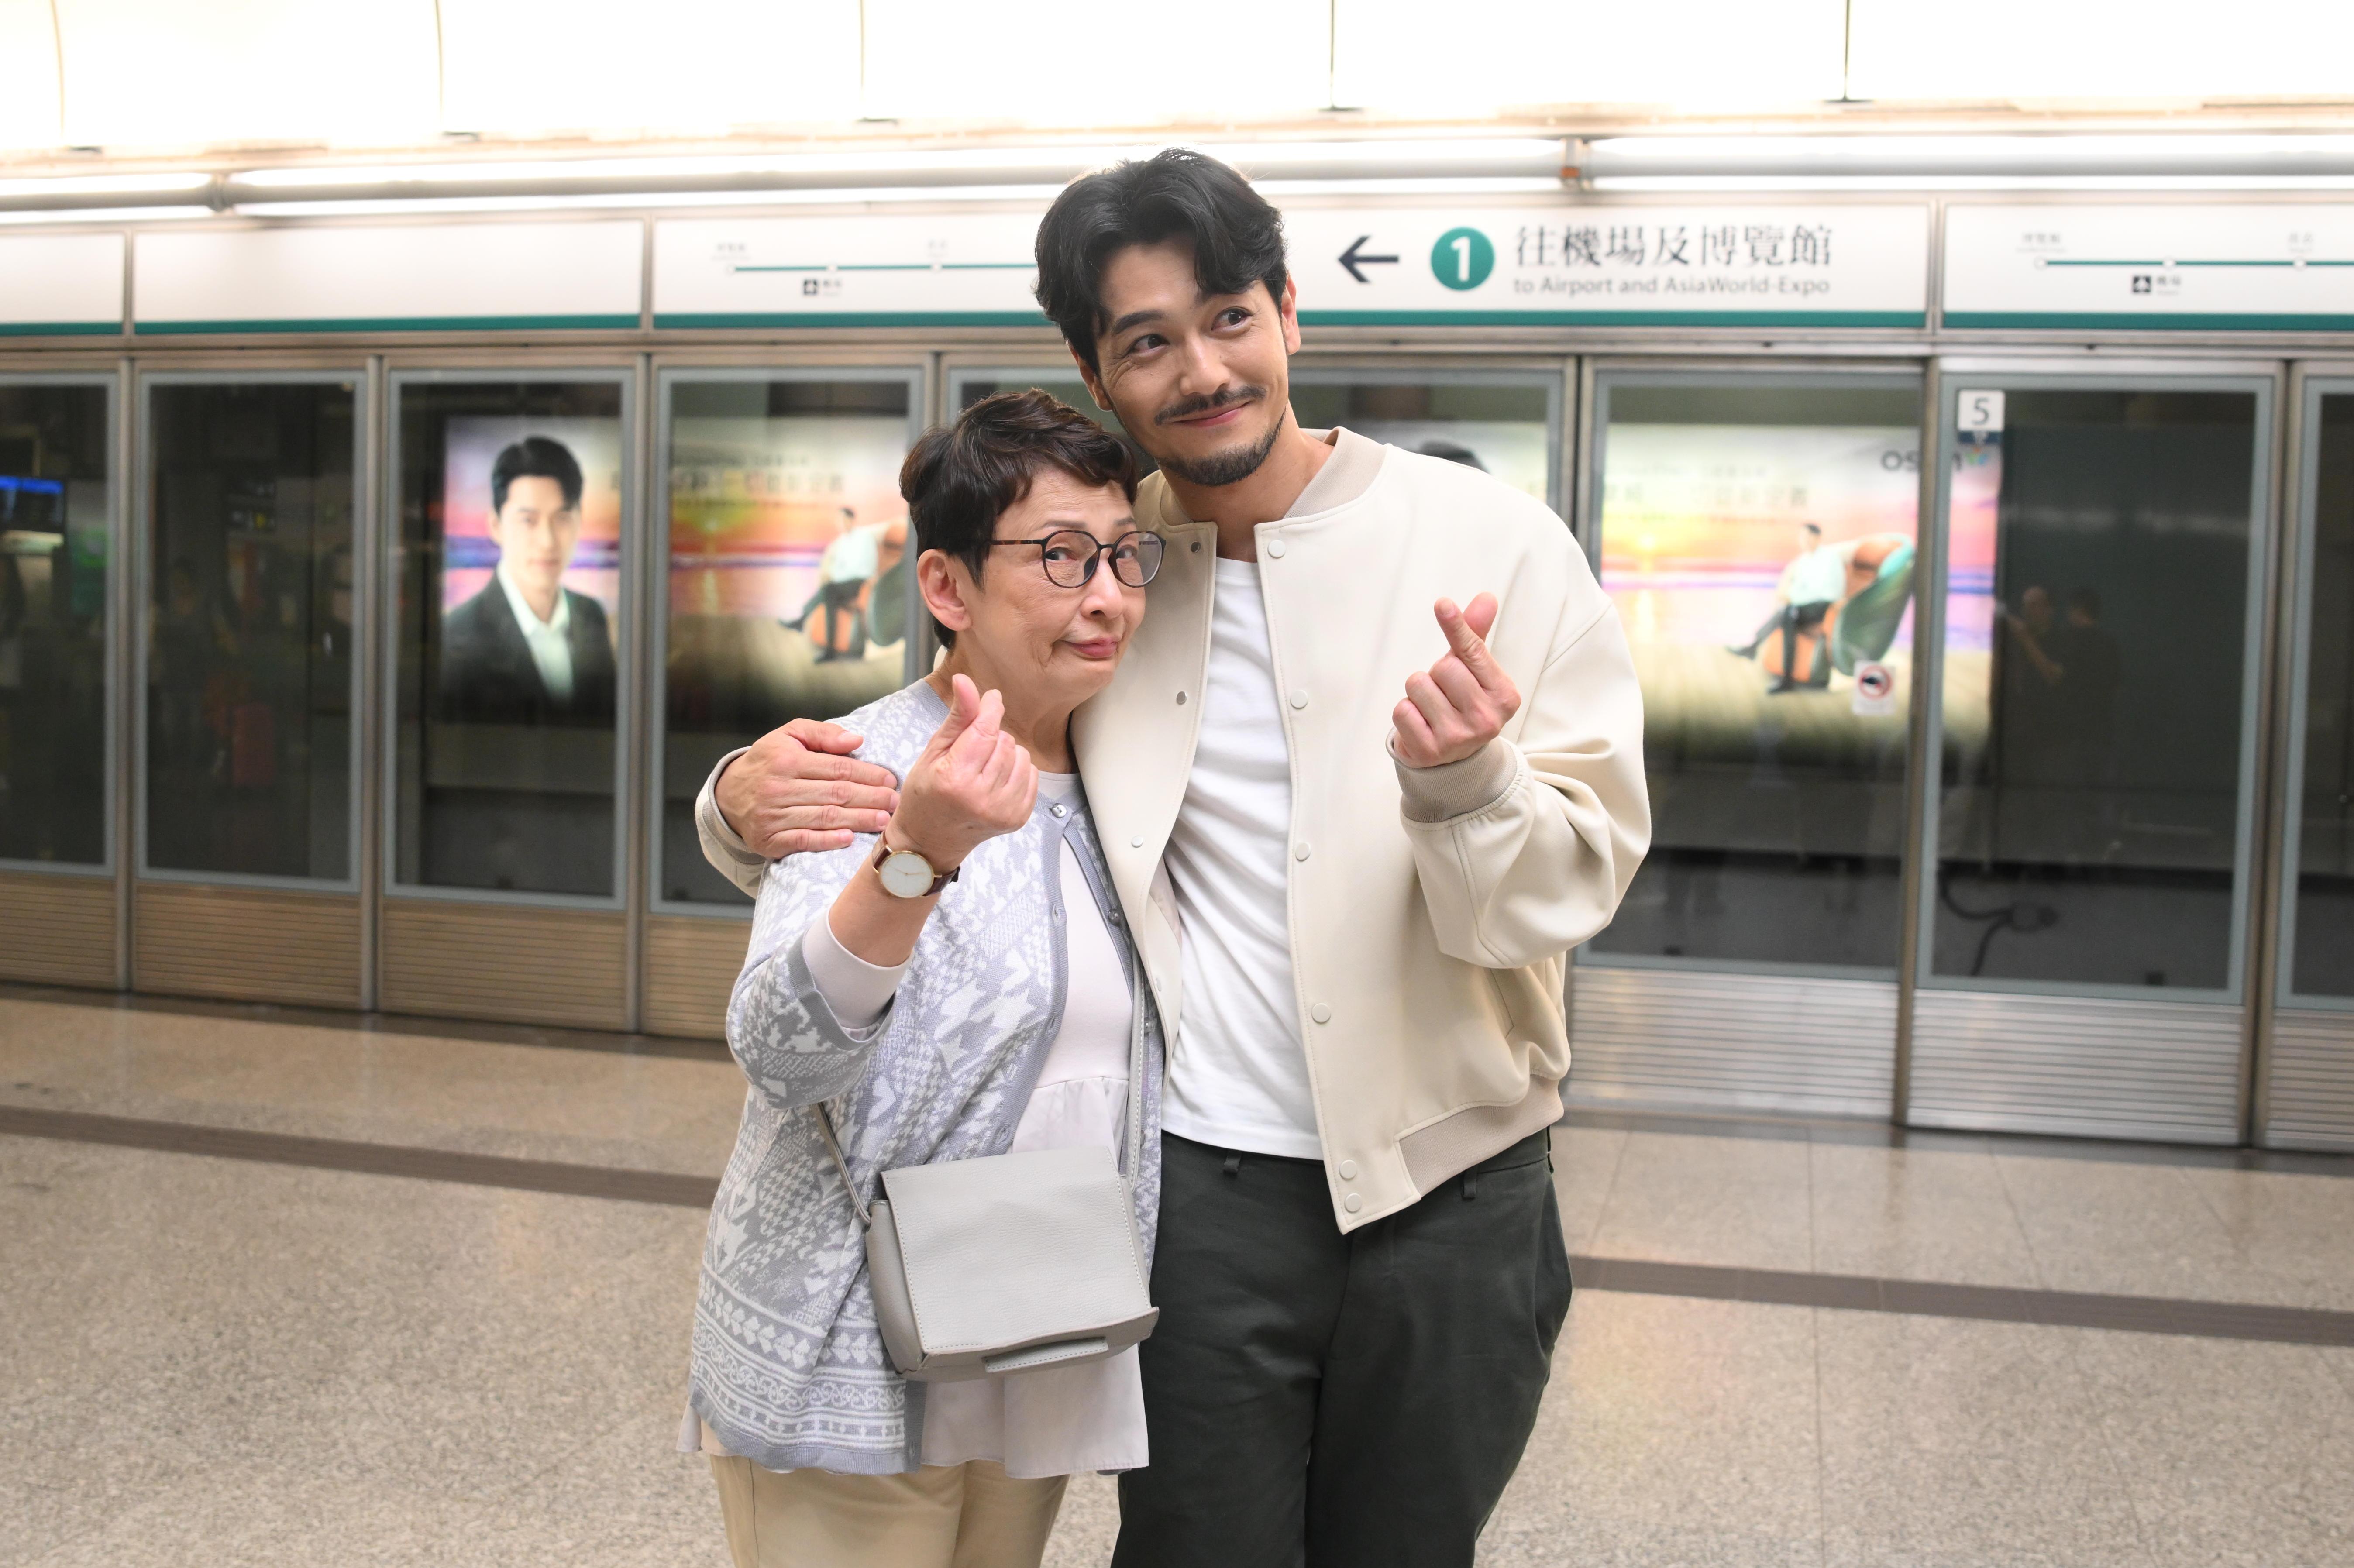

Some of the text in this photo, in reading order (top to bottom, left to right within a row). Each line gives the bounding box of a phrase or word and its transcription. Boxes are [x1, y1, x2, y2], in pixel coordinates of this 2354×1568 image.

[1450, 235, 1471, 282] 1
[1516, 224, 1831, 266] 往機場及博覽館
[1514, 279, 1535, 294] to
[1540, 276, 1612, 299] Airport
[1619, 276, 1658, 294] and
[1972, 397, 1989, 426] 5
